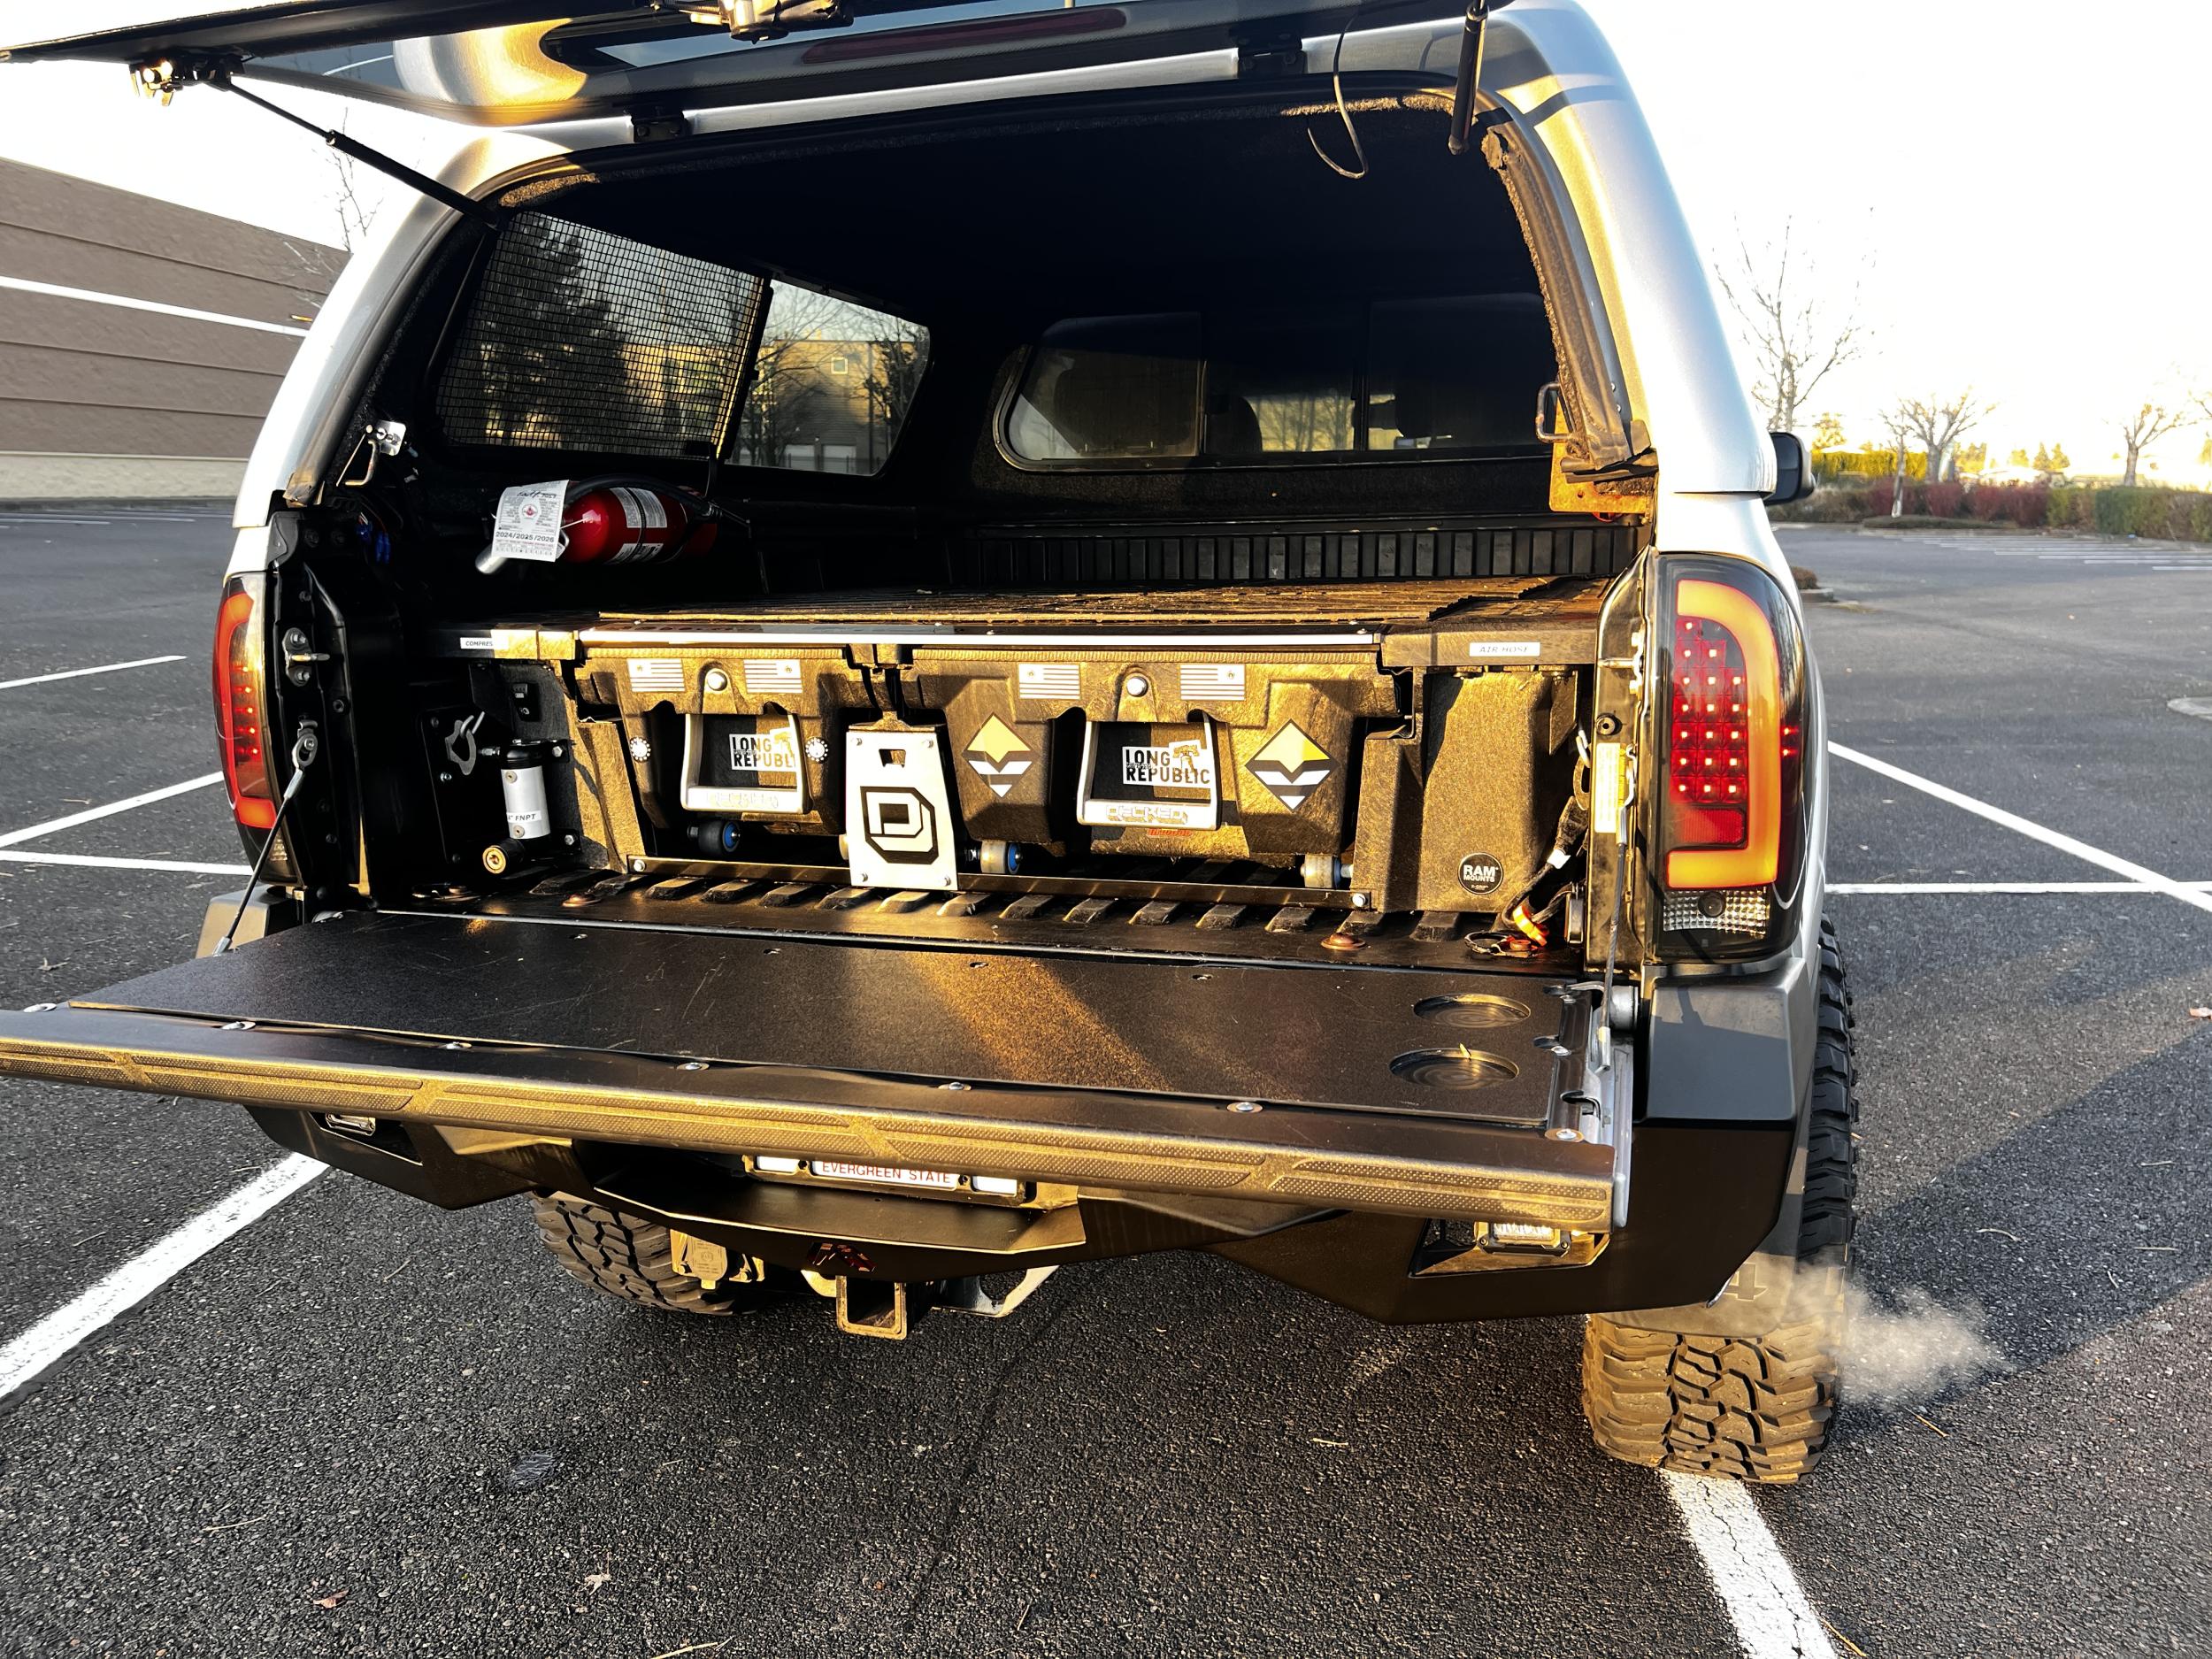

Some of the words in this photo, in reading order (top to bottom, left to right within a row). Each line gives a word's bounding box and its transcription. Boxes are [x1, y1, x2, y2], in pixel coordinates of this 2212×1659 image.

[1125, 749, 1171, 766] LONG
[1126, 766, 1210, 785] REPUBLIC
[1463, 864, 1496, 878] RAM
[822, 1161, 901, 1179] EVERGREEN
[909, 1169, 951, 1184] STATE
